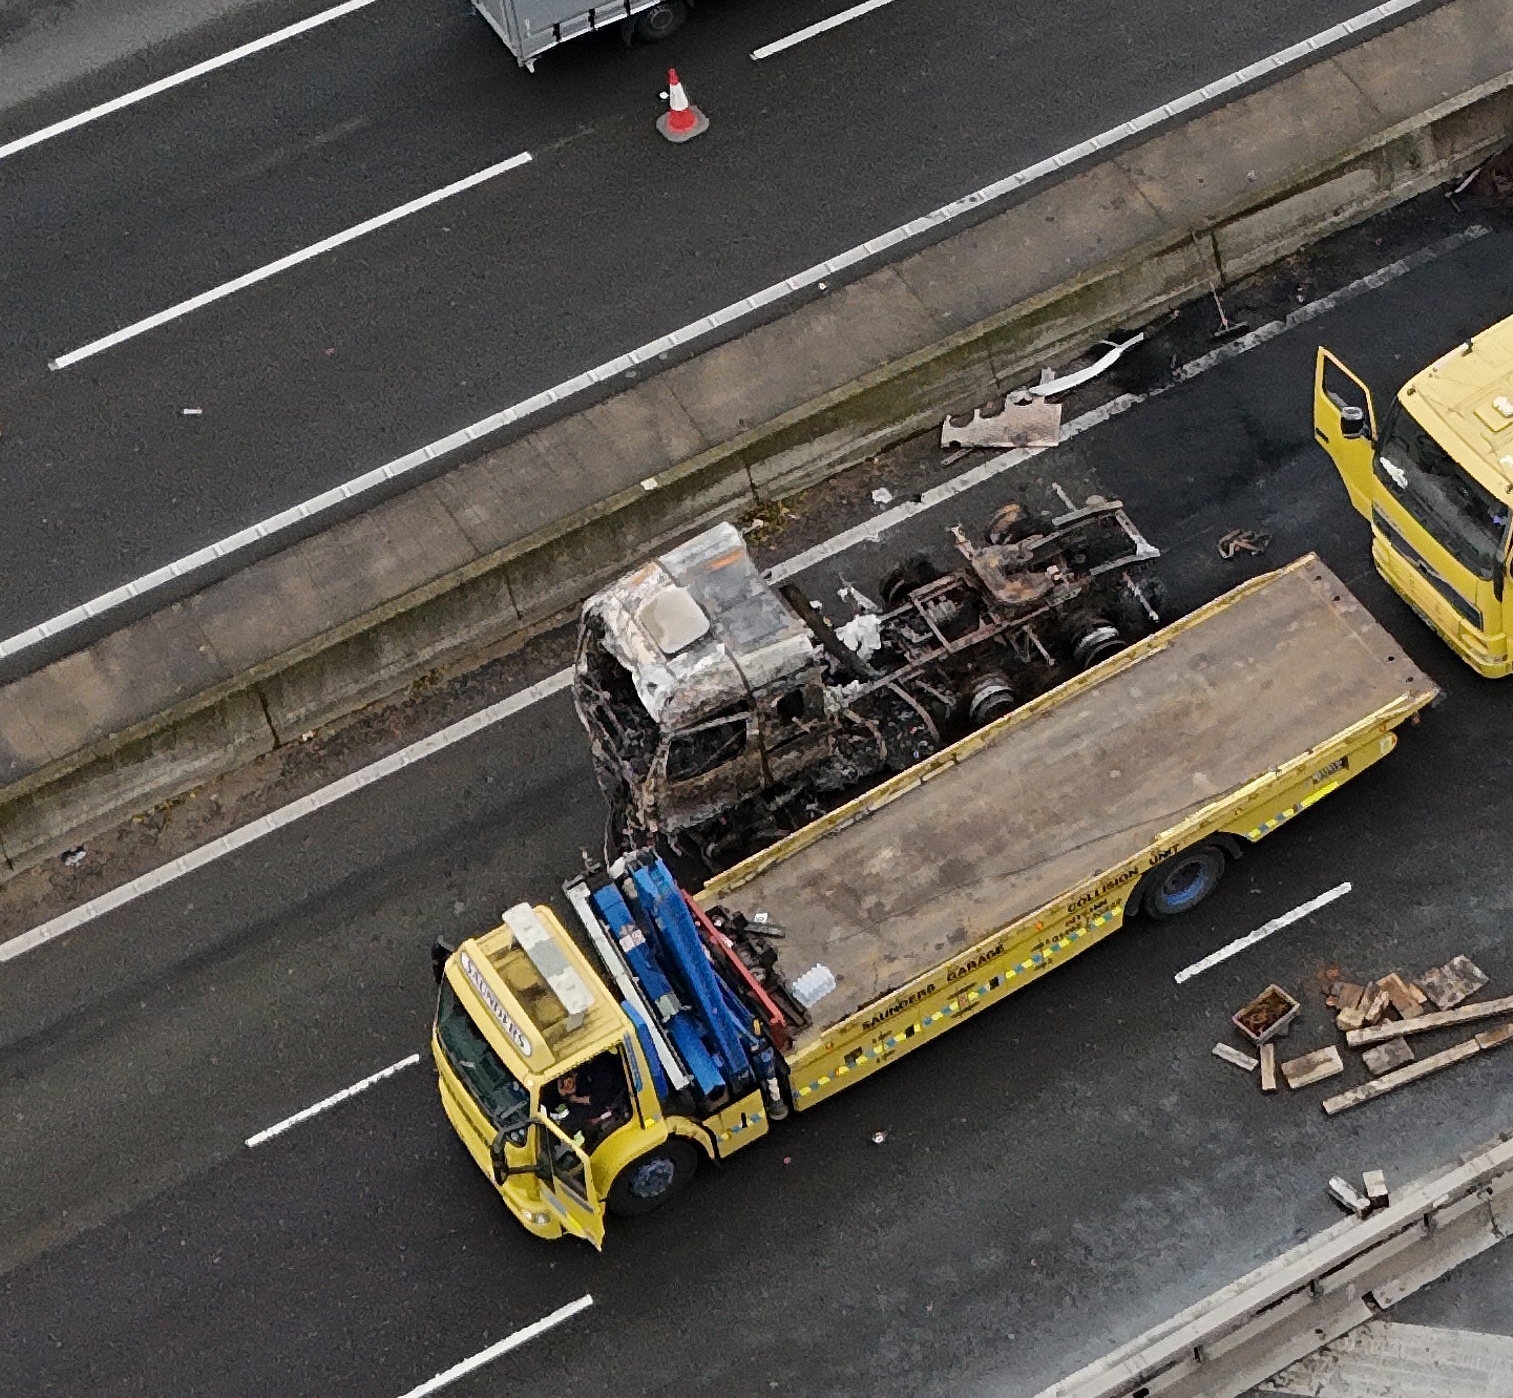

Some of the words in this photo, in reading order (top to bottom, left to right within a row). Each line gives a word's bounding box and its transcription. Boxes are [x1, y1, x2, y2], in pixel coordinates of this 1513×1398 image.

[466, 960, 525, 1048] SAUNDERS
[861, 982, 937, 1031] SAUNDERS
[945, 944, 1006, 981] GARAGE
[1066, 865, 1140, 913] COLLISION
[1148, 843, 1180, 875] UNIT
